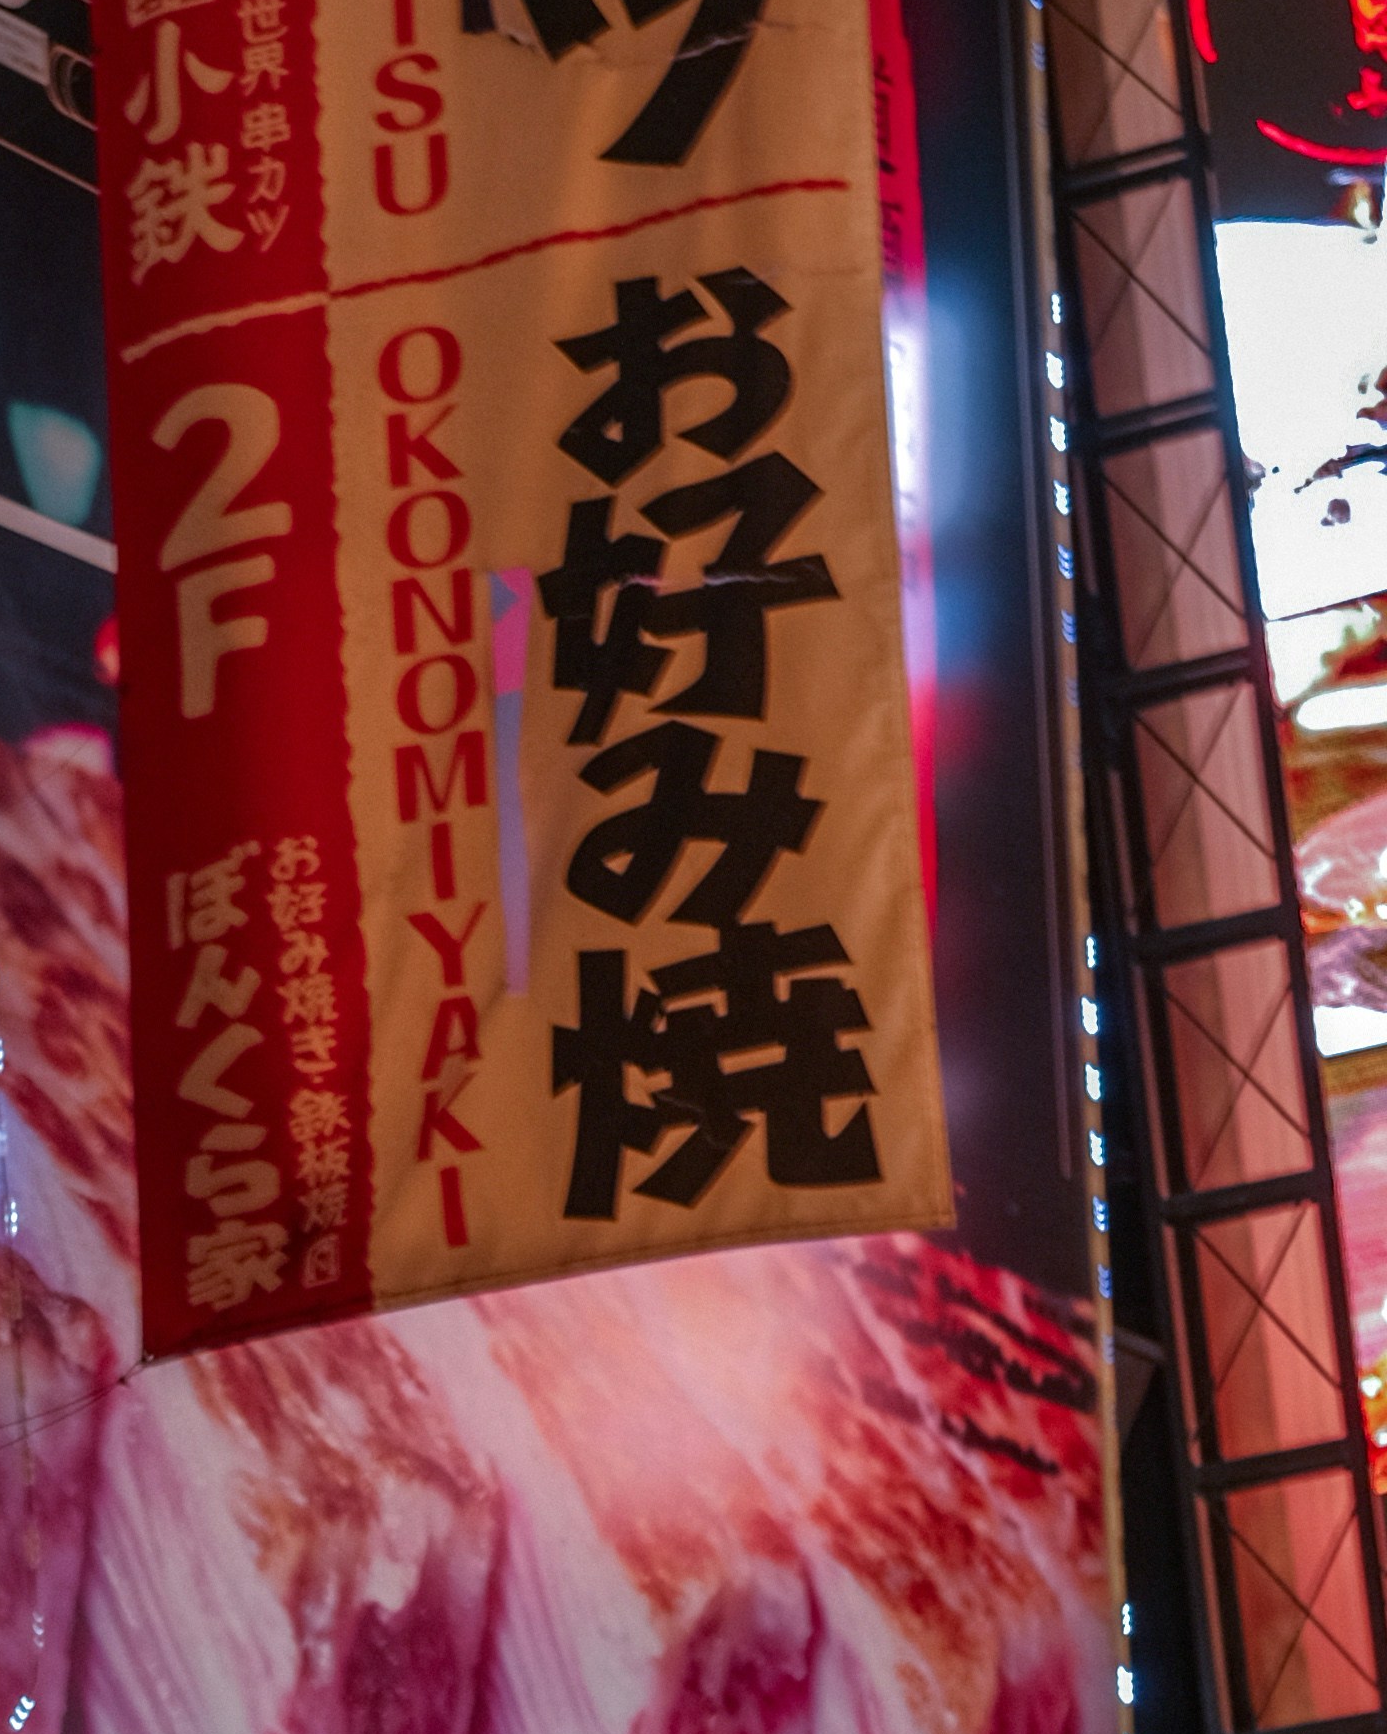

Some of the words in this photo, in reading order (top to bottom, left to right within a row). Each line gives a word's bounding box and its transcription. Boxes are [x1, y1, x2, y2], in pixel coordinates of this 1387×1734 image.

[123, 19, 246, 286] 小鉄
[151, 382, 294, 721] 2F
[376, 324, 491, 1248] OKONOMIYAKI
[538, 266, 885, 1222] お好み焼
[165, 839, 289, 1312] ぼんくら家
